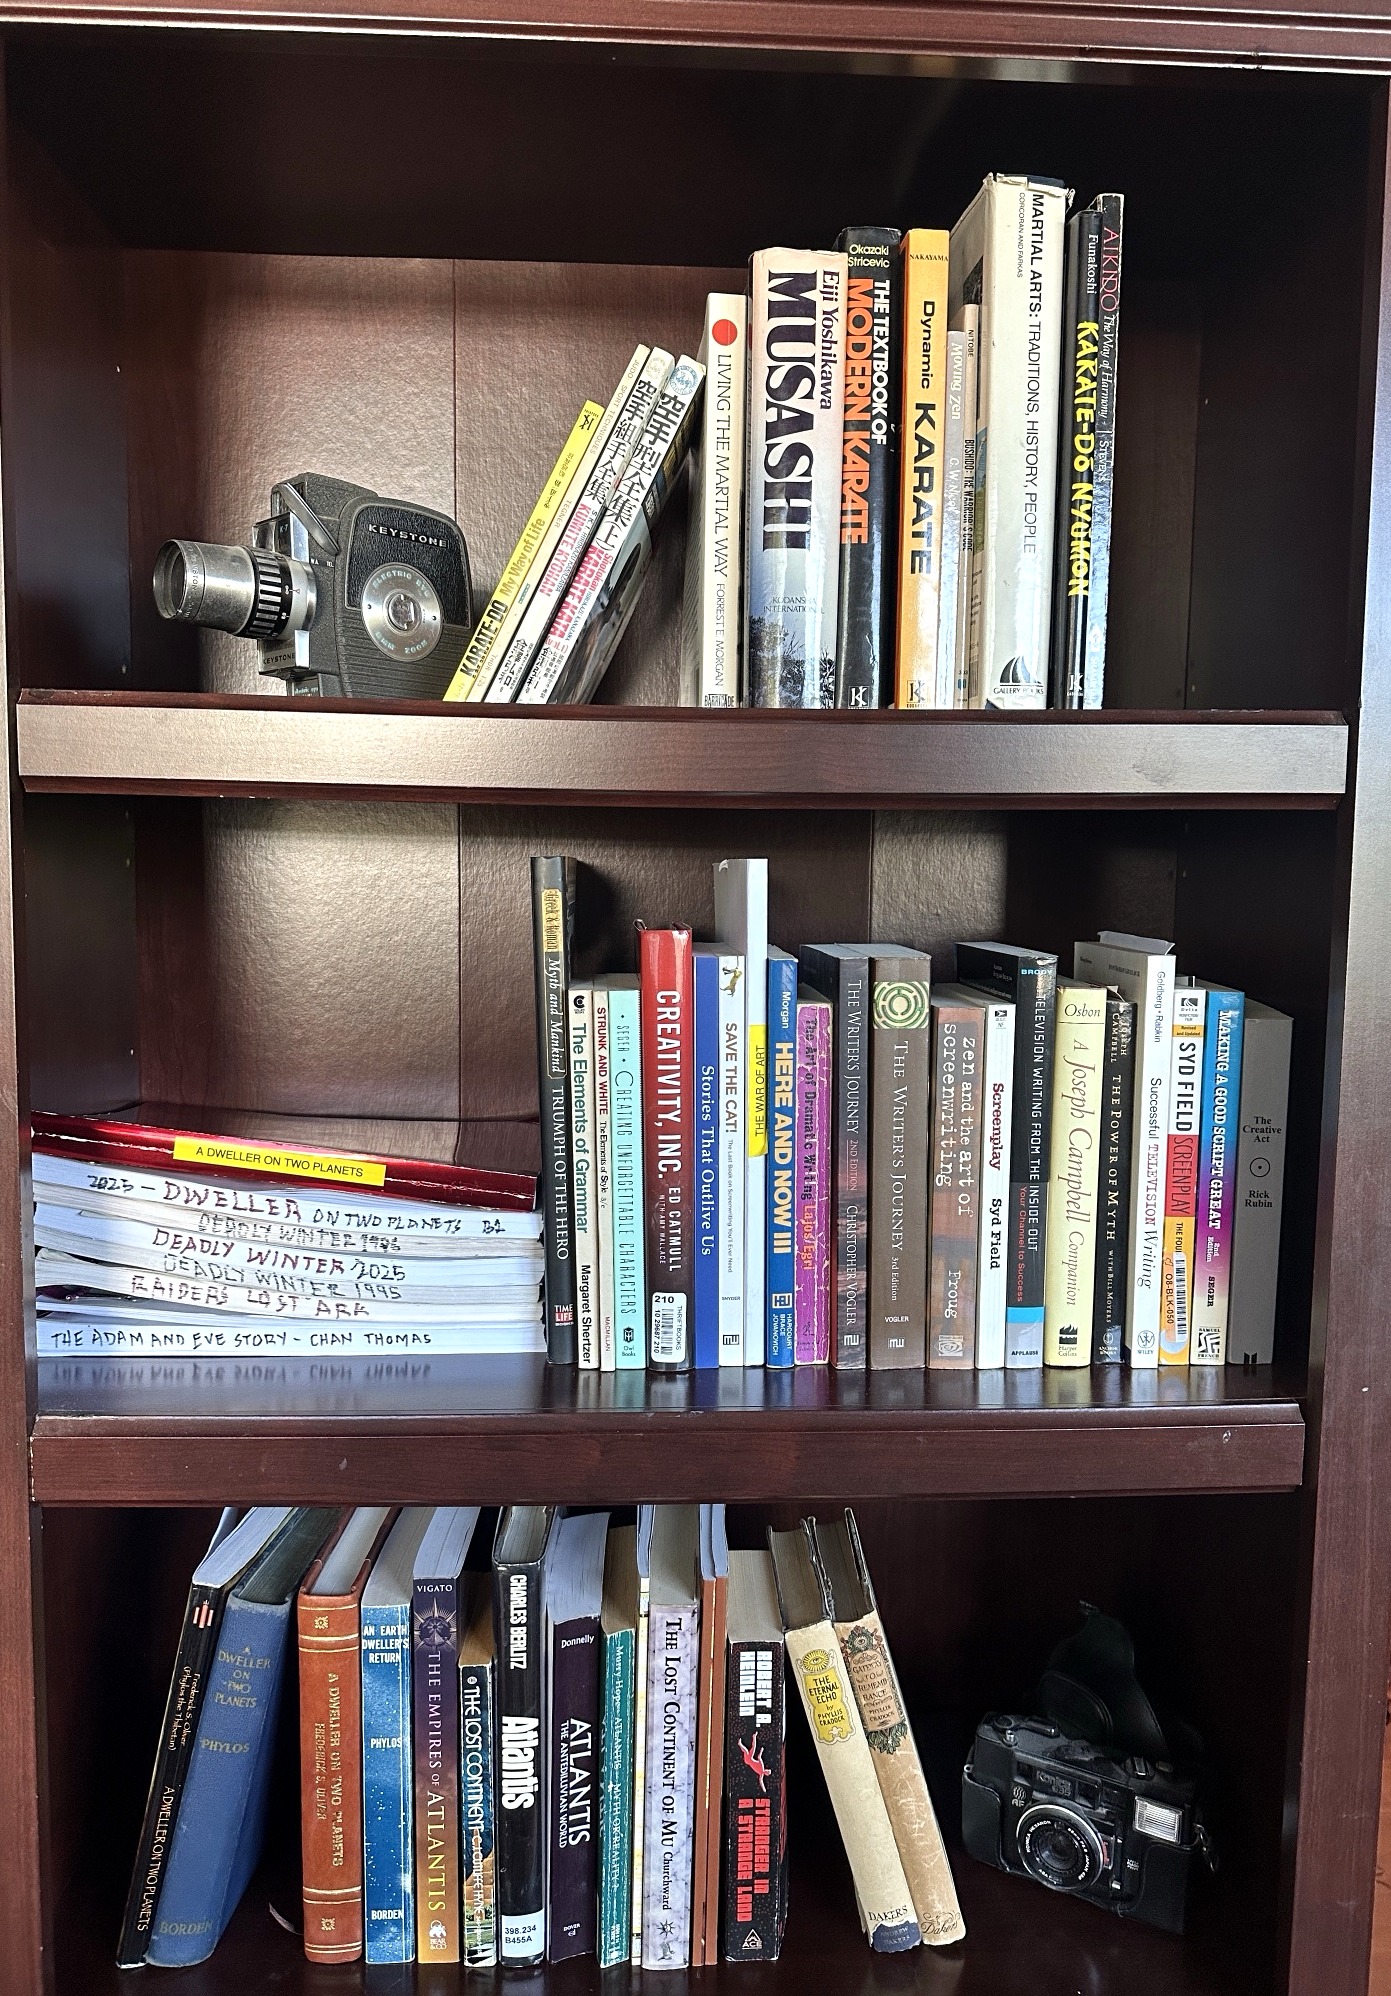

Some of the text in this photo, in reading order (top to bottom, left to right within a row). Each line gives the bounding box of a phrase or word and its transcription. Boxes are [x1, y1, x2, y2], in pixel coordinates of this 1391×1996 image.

[849, 244, 889, 256] Okazaki
[909, 253, 949, 262] NAKAYAMA
[1016, 192, 1026, 278] CORCORAN AND FARKAS
[848, 257, 891, 269] Stricevic
[1086, 234, 1099, 294] Funakoshi
[819, 270, 841, 410] Eiji Yoshikawa
[967, 329, 975, 358] NITOBE
[1098, 227, 1119, 419] AIKIDO The Way of Harmony
[871, 280, 891, 446] THE TEXTBOOK OF
[1023, 193, 1045, 554] MARTIAL ARTS: TRADITIONS, HISTORY, PEOPLE
[763, 270, 818, 553] MUSASHI
[841, 279, 874, 544] MODERN KARATE
[909, 301, 936, 575] Dynamic KARATE
[714, 354, 732, 577] LIVING THE MARTIAL WAY
[367, 523, 449, 548] KEYSTONE
[714, 583, 726, 628] FORREST
[262, 653, 296, 665] KEYSTONE
[713, 640, 726, 687] MORGAN
[704, 694, 736, 707] BARRICADE
[1153, 971, 1167, 1043] Goldberg Rabkin
[1110, 1013, 1121, 1064] CAMPBELL
[1178, 1042, 1197, 1077] SYD
[754, 1045, 764, 1136] THE WAR OF ART
[935, 1023, 958, 1188] screenwriting
[1175, 1081, 1196, 1133] FIELD
[1027, 994, 1047, 1252] TELEVISION WRITING FROM THE INSIDE OUT
[1208, 1010, 1232, 1230] MAKING A GOOD SCRIPT GREAT
[1242, 1124, 1282, 1135] Creative
[1253, 1115, 1272, 1125] The
[1253, 1134, 1271, 1143] Act
[196, 1146, 365, 1178] A DWELLER ON TWO PLANETS
[701, 1064, 716, 1254] Stories That Outlive Us
[989, 1082, 1005, 1270] Screenplay Syd Field
[1106, 1074, 1123, 1241] THE POWER OF MYTH
[1169, 1136, 1194, 1215] SCREENPLAY
[1244, 1198, 1273, 1208] Rubin
[1248, 1189, 1270, 1199] Rick
[658, 1194, 667, 1264] WITH AMY WALLACE
[1205, 1235, 1214, 1263] Edition
[152, 1228, 406, 1282] DEADLY WINTER 2025
[579, 1264, 595, 1364] Margaret Shertzer
[655, 1295, 674, 1303] 210
[943, 1269, 962, 1319] Froug
[1206, 1275, 1216, 1307] SEGER
[51, 1328, 432, 1351] THE ADAM AND EVE STORY CHAN THOMAS
[772, 1313, 780, 1356] JOVANOVICH
[779, 1313, 787, 1337] BRACE
[785, 1313, 793, 1349] HARCOURT
[416, 1584, 454, 1594] VIGATO
[361, 1638, 411, 1650] DWELLER'S
[362, 1625, 411, 1637] AN EARTH
[510, 1574, 528, 1670] CHARLES BERLITZ
[664, 1618, 683, 1651] THE
[232, 1669, 251, 1680] ON
[369, 1652, 402, 1664] RETURN
[664, 1656, 682, 1696] LOST
[817, 1709, 844, 1721] PHYLLIS
[861, 1689, 888, 1701] RANCE
[370, 1738, 403, 1749] PHYLOS
[501, 1716, 540, 1810] Atlantis
[662, 1701, 681, 1789] CONTINENT
[328, 1672, 344, 1867] A DWELLER ON TWO PLANETS
[427, 1651, 447, 1911] THE EMPIRES OF ATLANTIS
[558, 1721, 570, 1849] THE ANTEDILUVIAN WORLD
[567, 1717, 592, 1847] ATLANTIS
[661, 1794, 675, 1815] OF
[137, 1786, 176, 1932] A DWELLER ON TWO PLANETS
[661, 1850, 673, 1911] Churchward
[736, 1798, 754, 1922] A STRANGE LAND
[371, 1909, 405, 1920] BORDEN
[503, 1926, 538, 1936] 398.234
[505, 1936, 534, 1946] B455A
